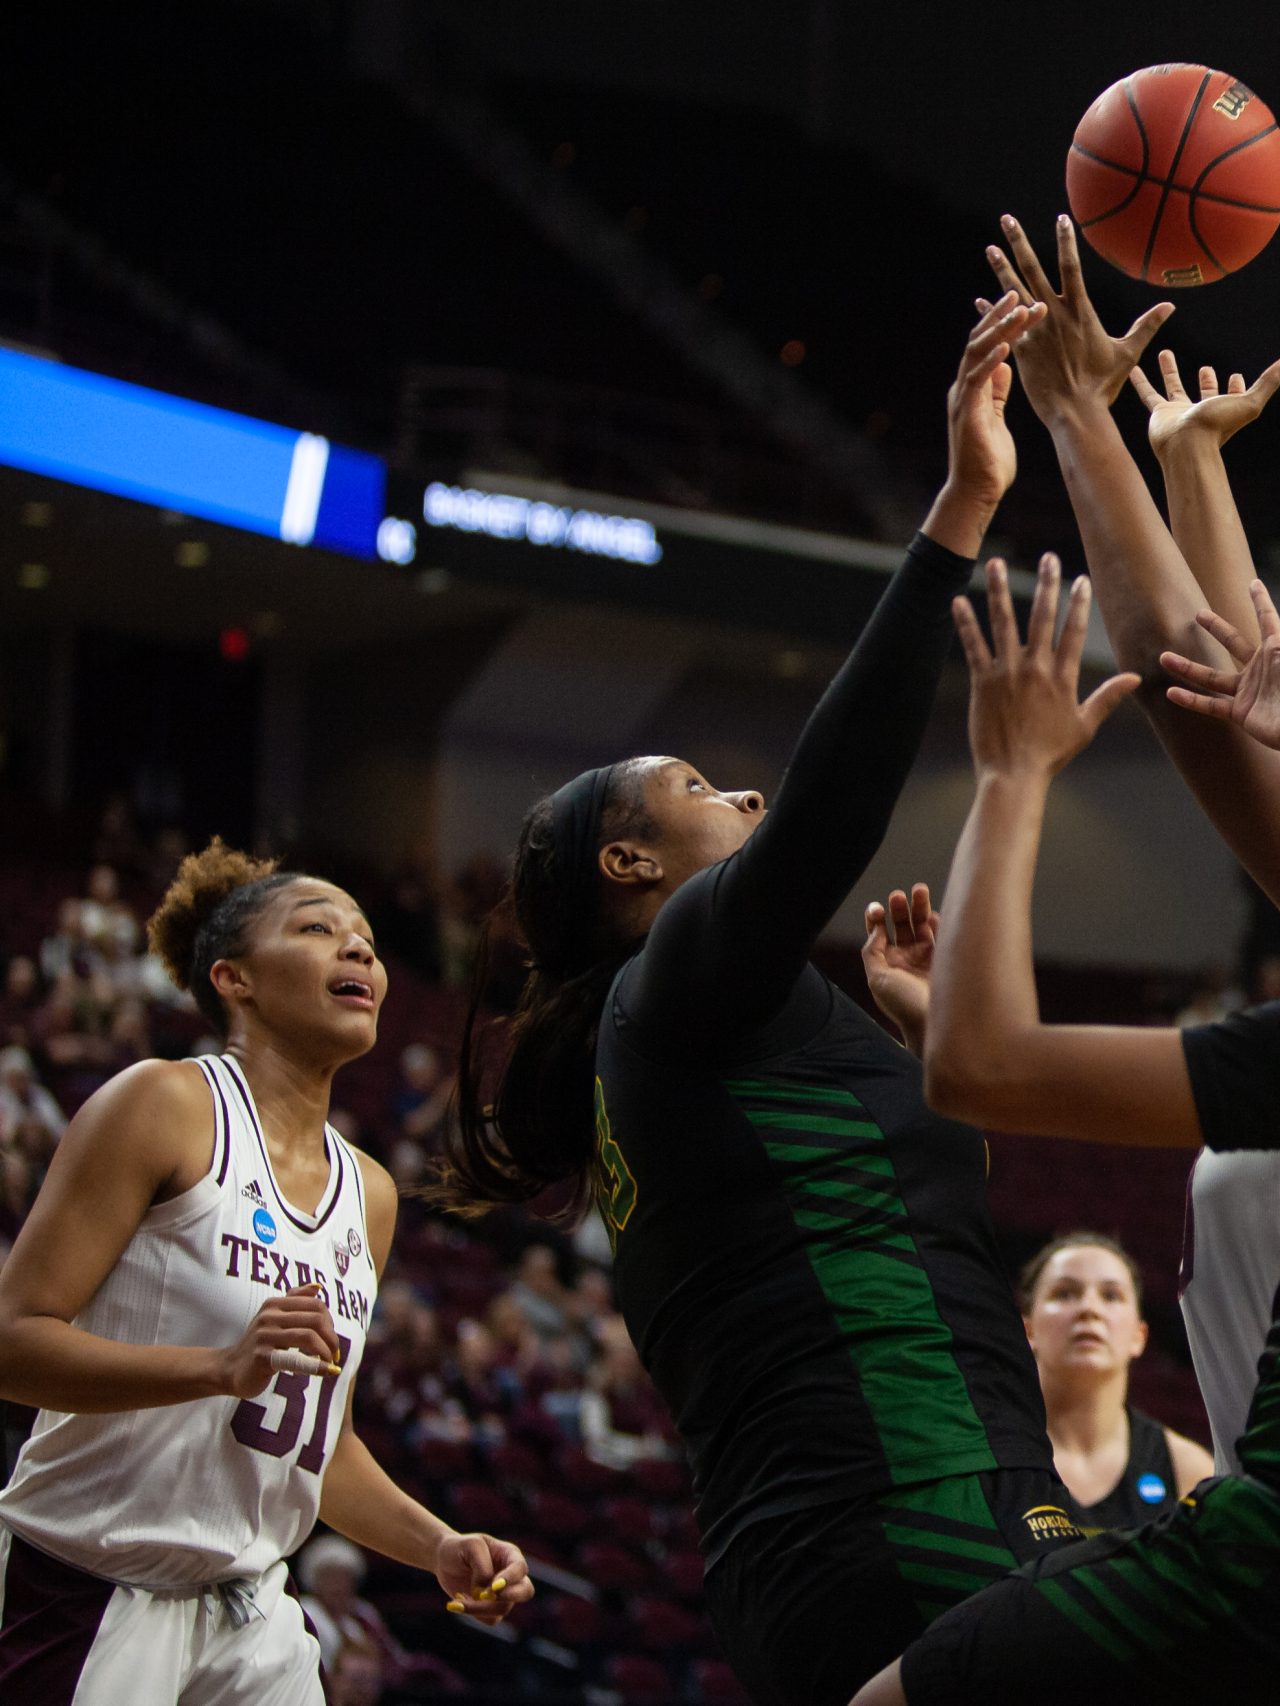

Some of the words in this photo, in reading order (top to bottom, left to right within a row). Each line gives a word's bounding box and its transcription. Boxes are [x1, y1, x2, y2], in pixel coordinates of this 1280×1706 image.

[241, 1189, 268, 1210] adidas
[221, 1233, 330, 1310] TEXAS
[334, 1278, 368, 1330] A&M
[230, 1333, 351, 1475] 31
